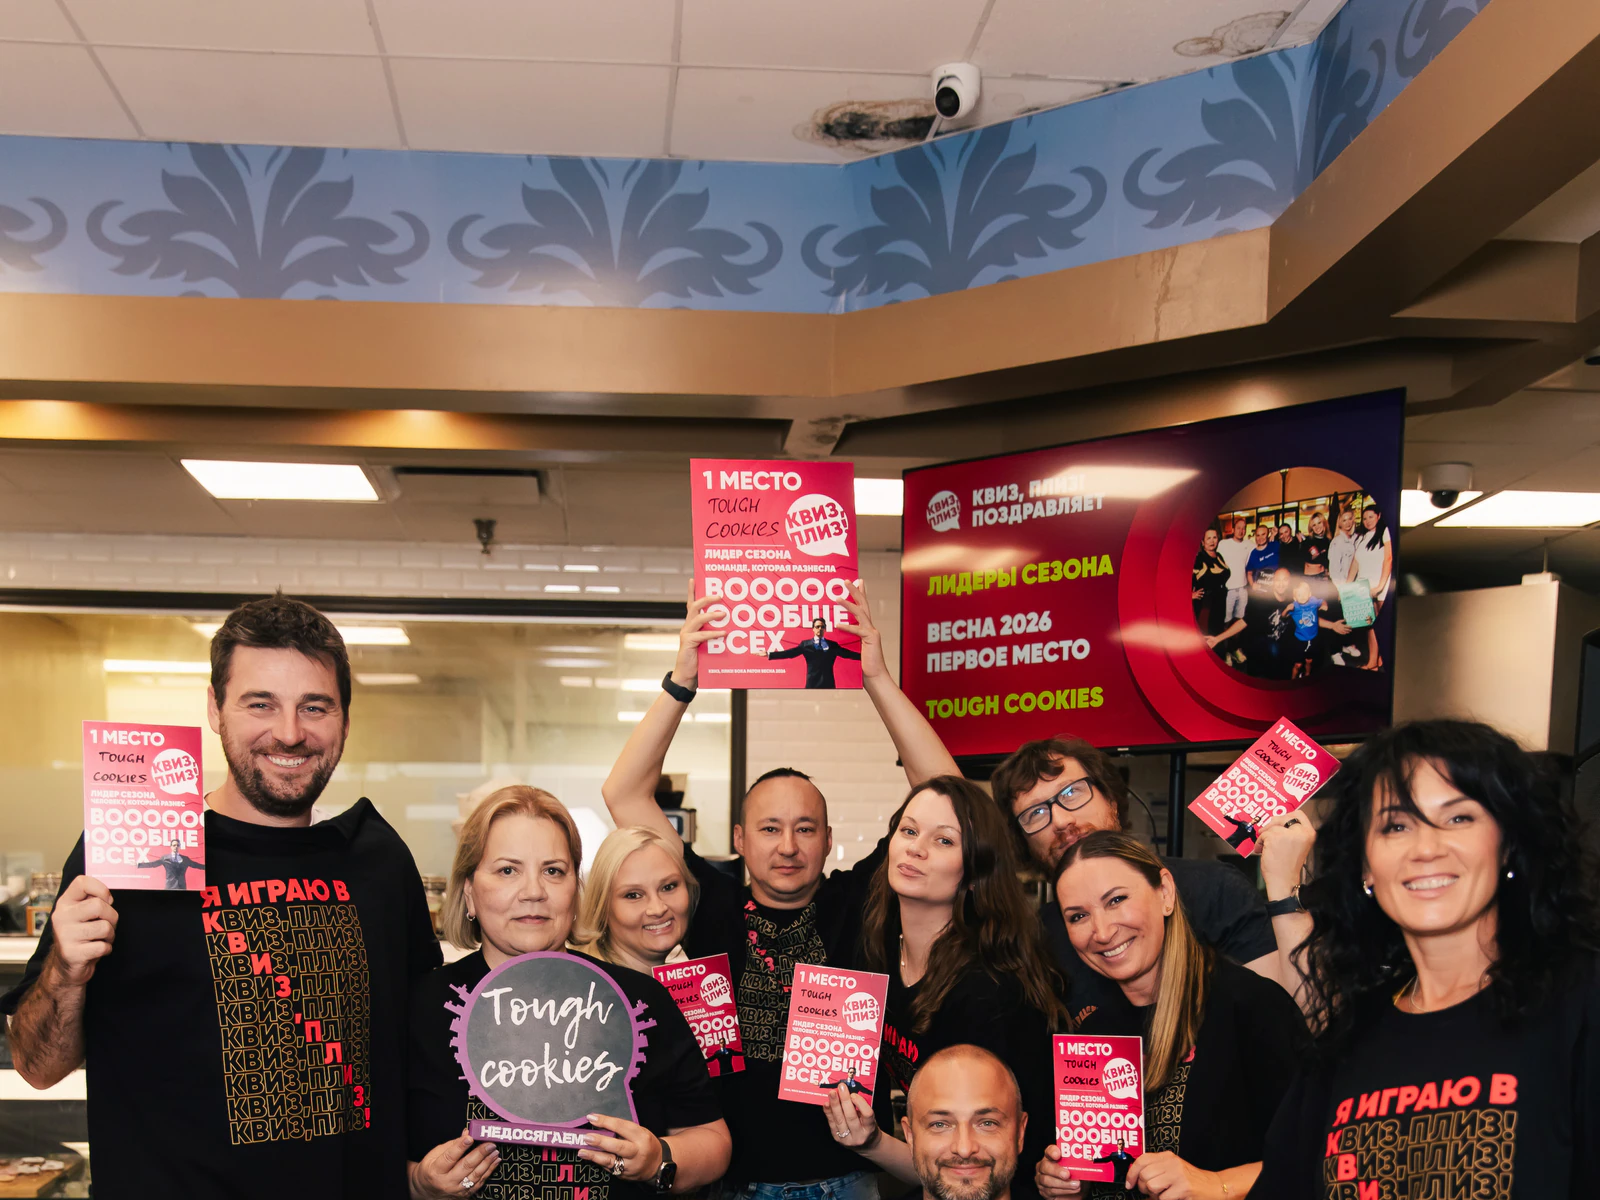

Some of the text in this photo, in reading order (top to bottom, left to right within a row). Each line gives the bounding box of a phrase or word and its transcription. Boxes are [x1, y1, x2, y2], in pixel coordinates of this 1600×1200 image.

[703, 471, 801, 490] 1 МЕСТО
[972, 483, 1024, 507] КВИЗ,
[972, 493, 1105, 527] ПОЗДРАВЛЯЕТ
[705, 549, 791, 559] ЛИДЕР СЕЗОНА
[706, 564, 750, 572] КОМАНДЕ,
[927, 554, 1114, 596] ЛИДЕРЫ СЕЗОНА
[927, 611, 1052, 643] ВЕСНА 2026
[707, 630, 784, 654] ВСЕХ
[927, 638, 1090, 673] ПЕРВОЕ МЕСТО
[926, 686, 1104, 719] TOUGH COOKIES
[90, 730, 164, 746] 1 МЕСТО
[1276, 725, 1316, 759] 1 МЕСТО
[1205, 788, 1241, 818] ВСЕХ
[91, 847, 150, 865] ВСЕХ
[200, 879, 350, 908] Я ИГРАЮ В
[658, 964, 706, 981] 1 МЕСТО
[800, 971, 856, 988] 1 МЕСТО
[481, 982, 613, 1049] Tough
[793, 1020, 842, 1032] ЛИДЕР СЕЗОНА
[1059, 1042, 1112, 1056] 1 МЕСТО
[480, 1043, 623, 1092] cookies
[786, 1066, 831, 1084] ВСЕХ
[1333, 1073, 1518, 1127] Я ИГРАЮ В
[480, 1125, 588, 1146] НЕДОСЯГАЕМ
[1061, 1143, 1102, 1160] ВСЕХ
